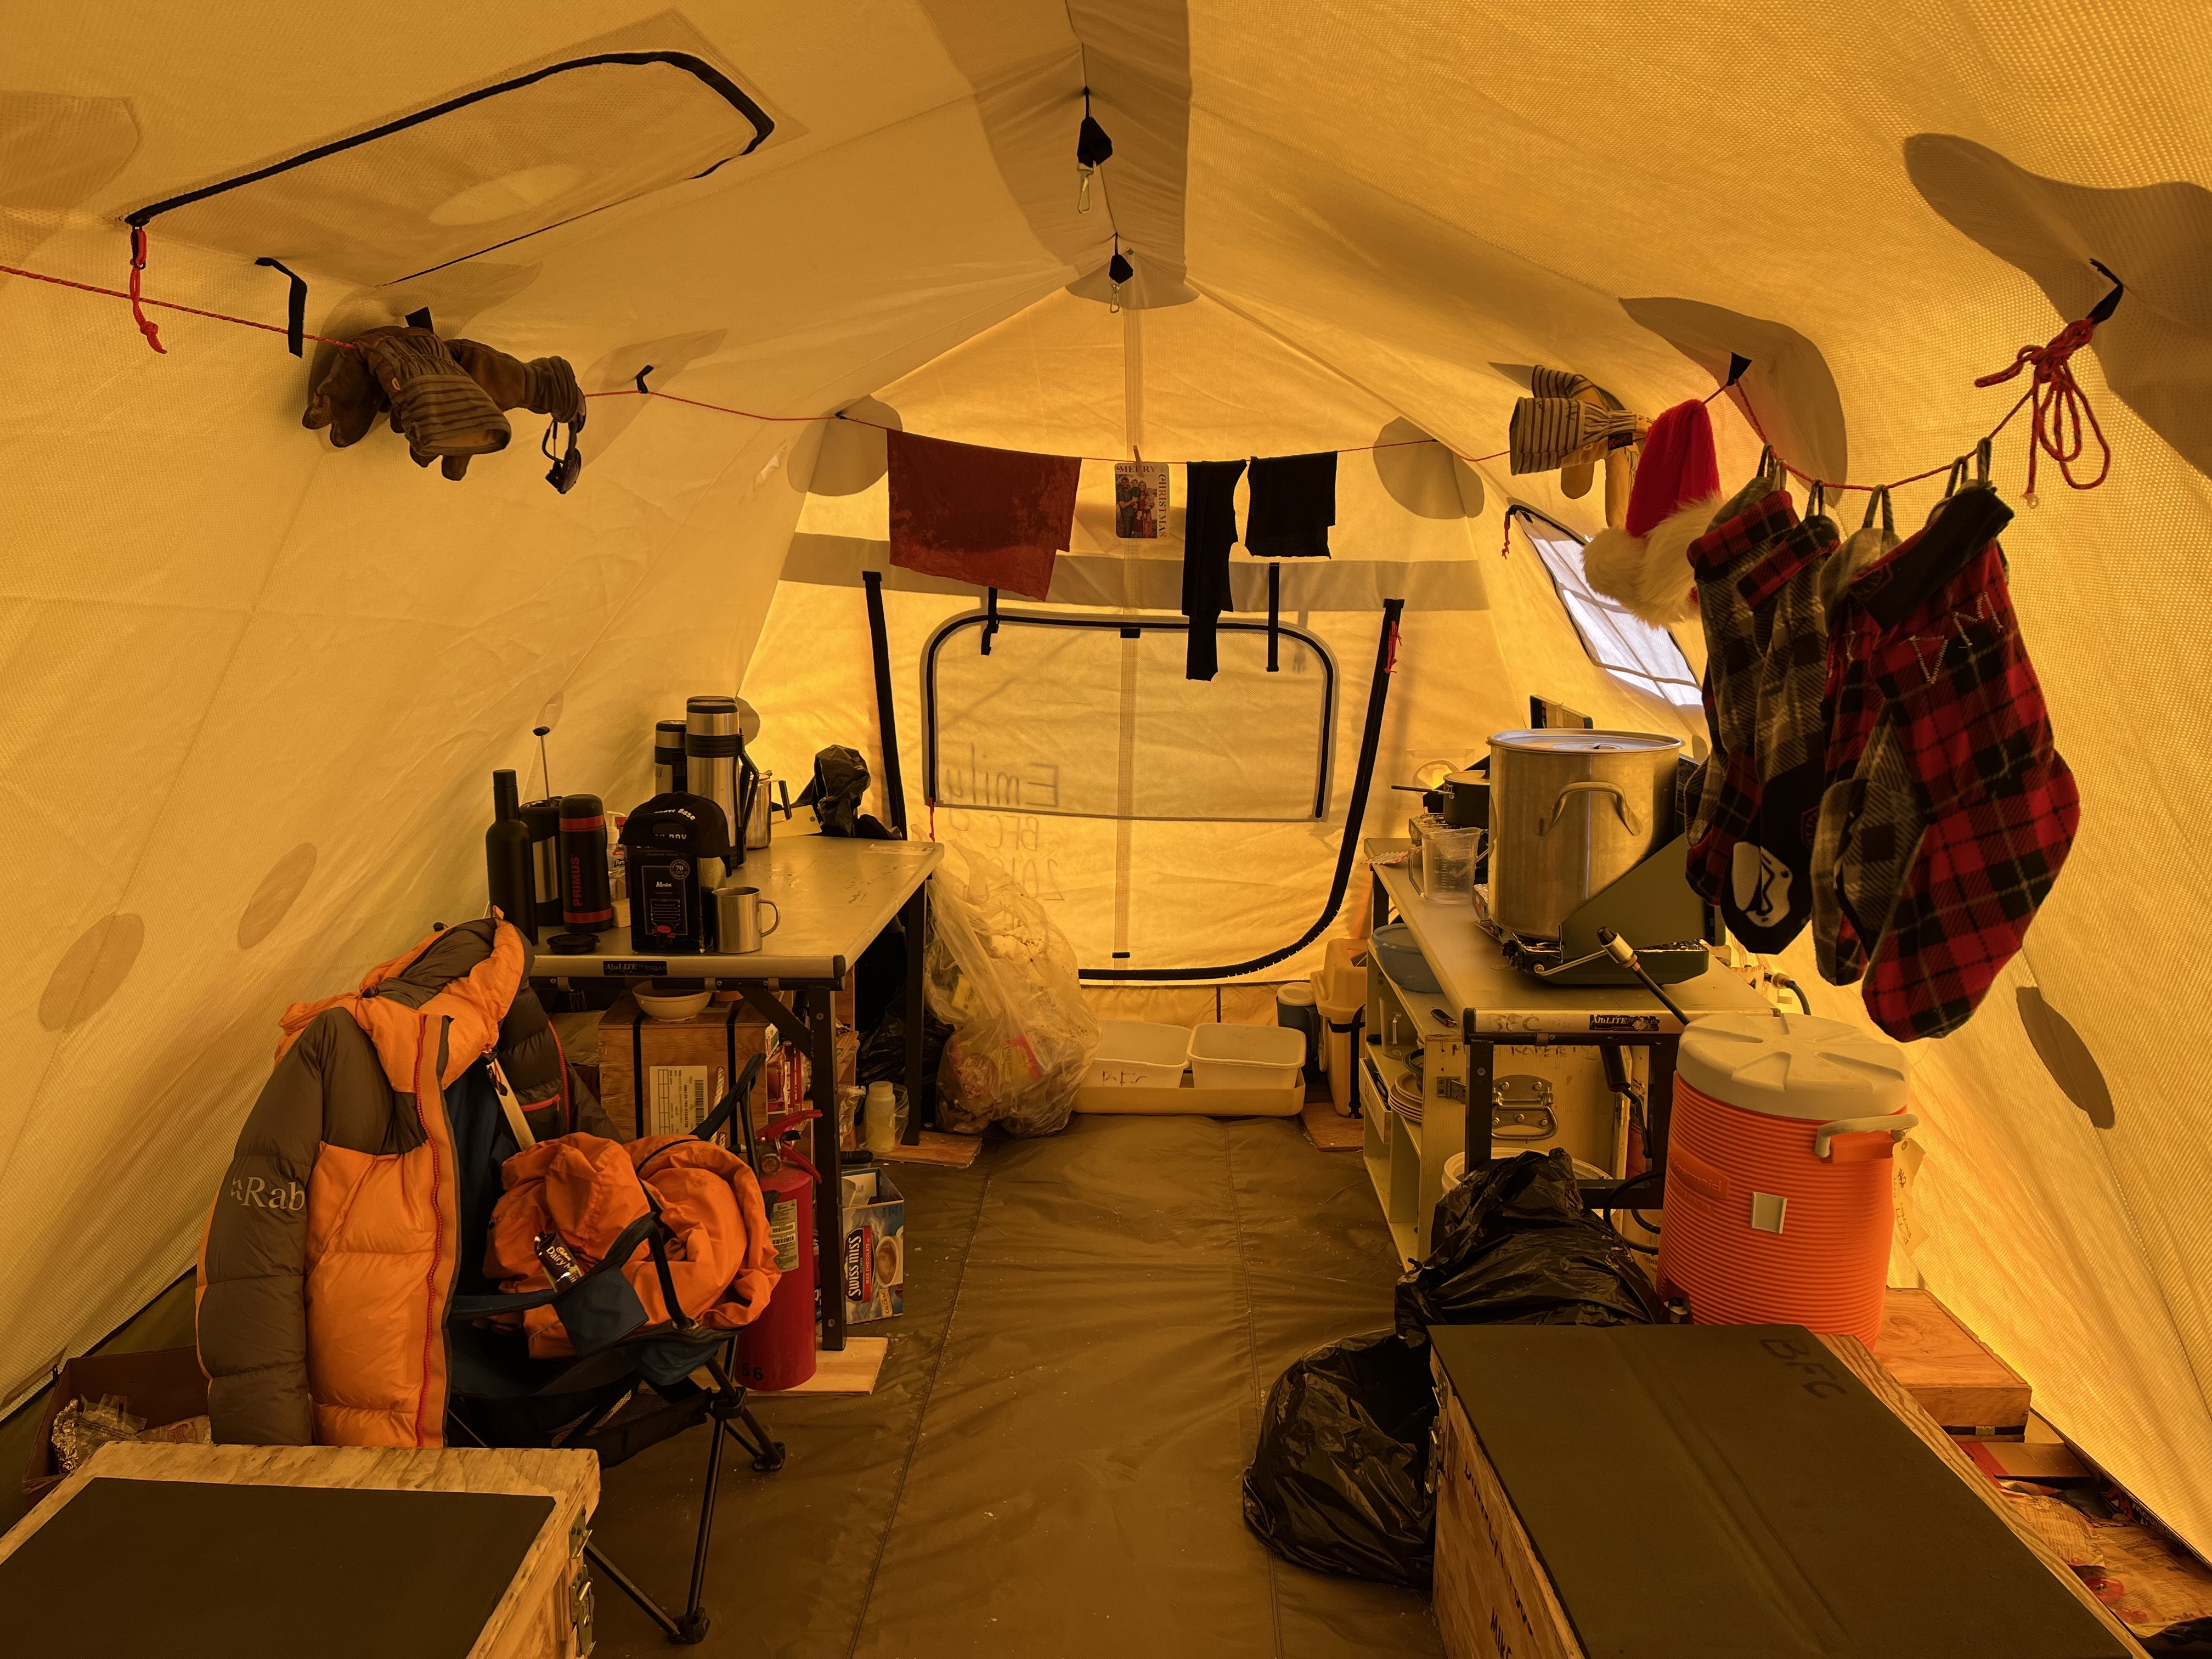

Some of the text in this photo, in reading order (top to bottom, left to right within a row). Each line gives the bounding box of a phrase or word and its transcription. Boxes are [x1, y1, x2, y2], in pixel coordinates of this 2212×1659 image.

[1158, 474, 1166, 538] CHRISTMAS
[571, 856, 583, 906] PRIMUS
[241, 1177, 306, 1210] Rab
[546, 1246, 567, 1266] Dairy
[848, 1235, 862, 1296] SWISS MISS
[1758, 1338, 1847, 1400] BFC
